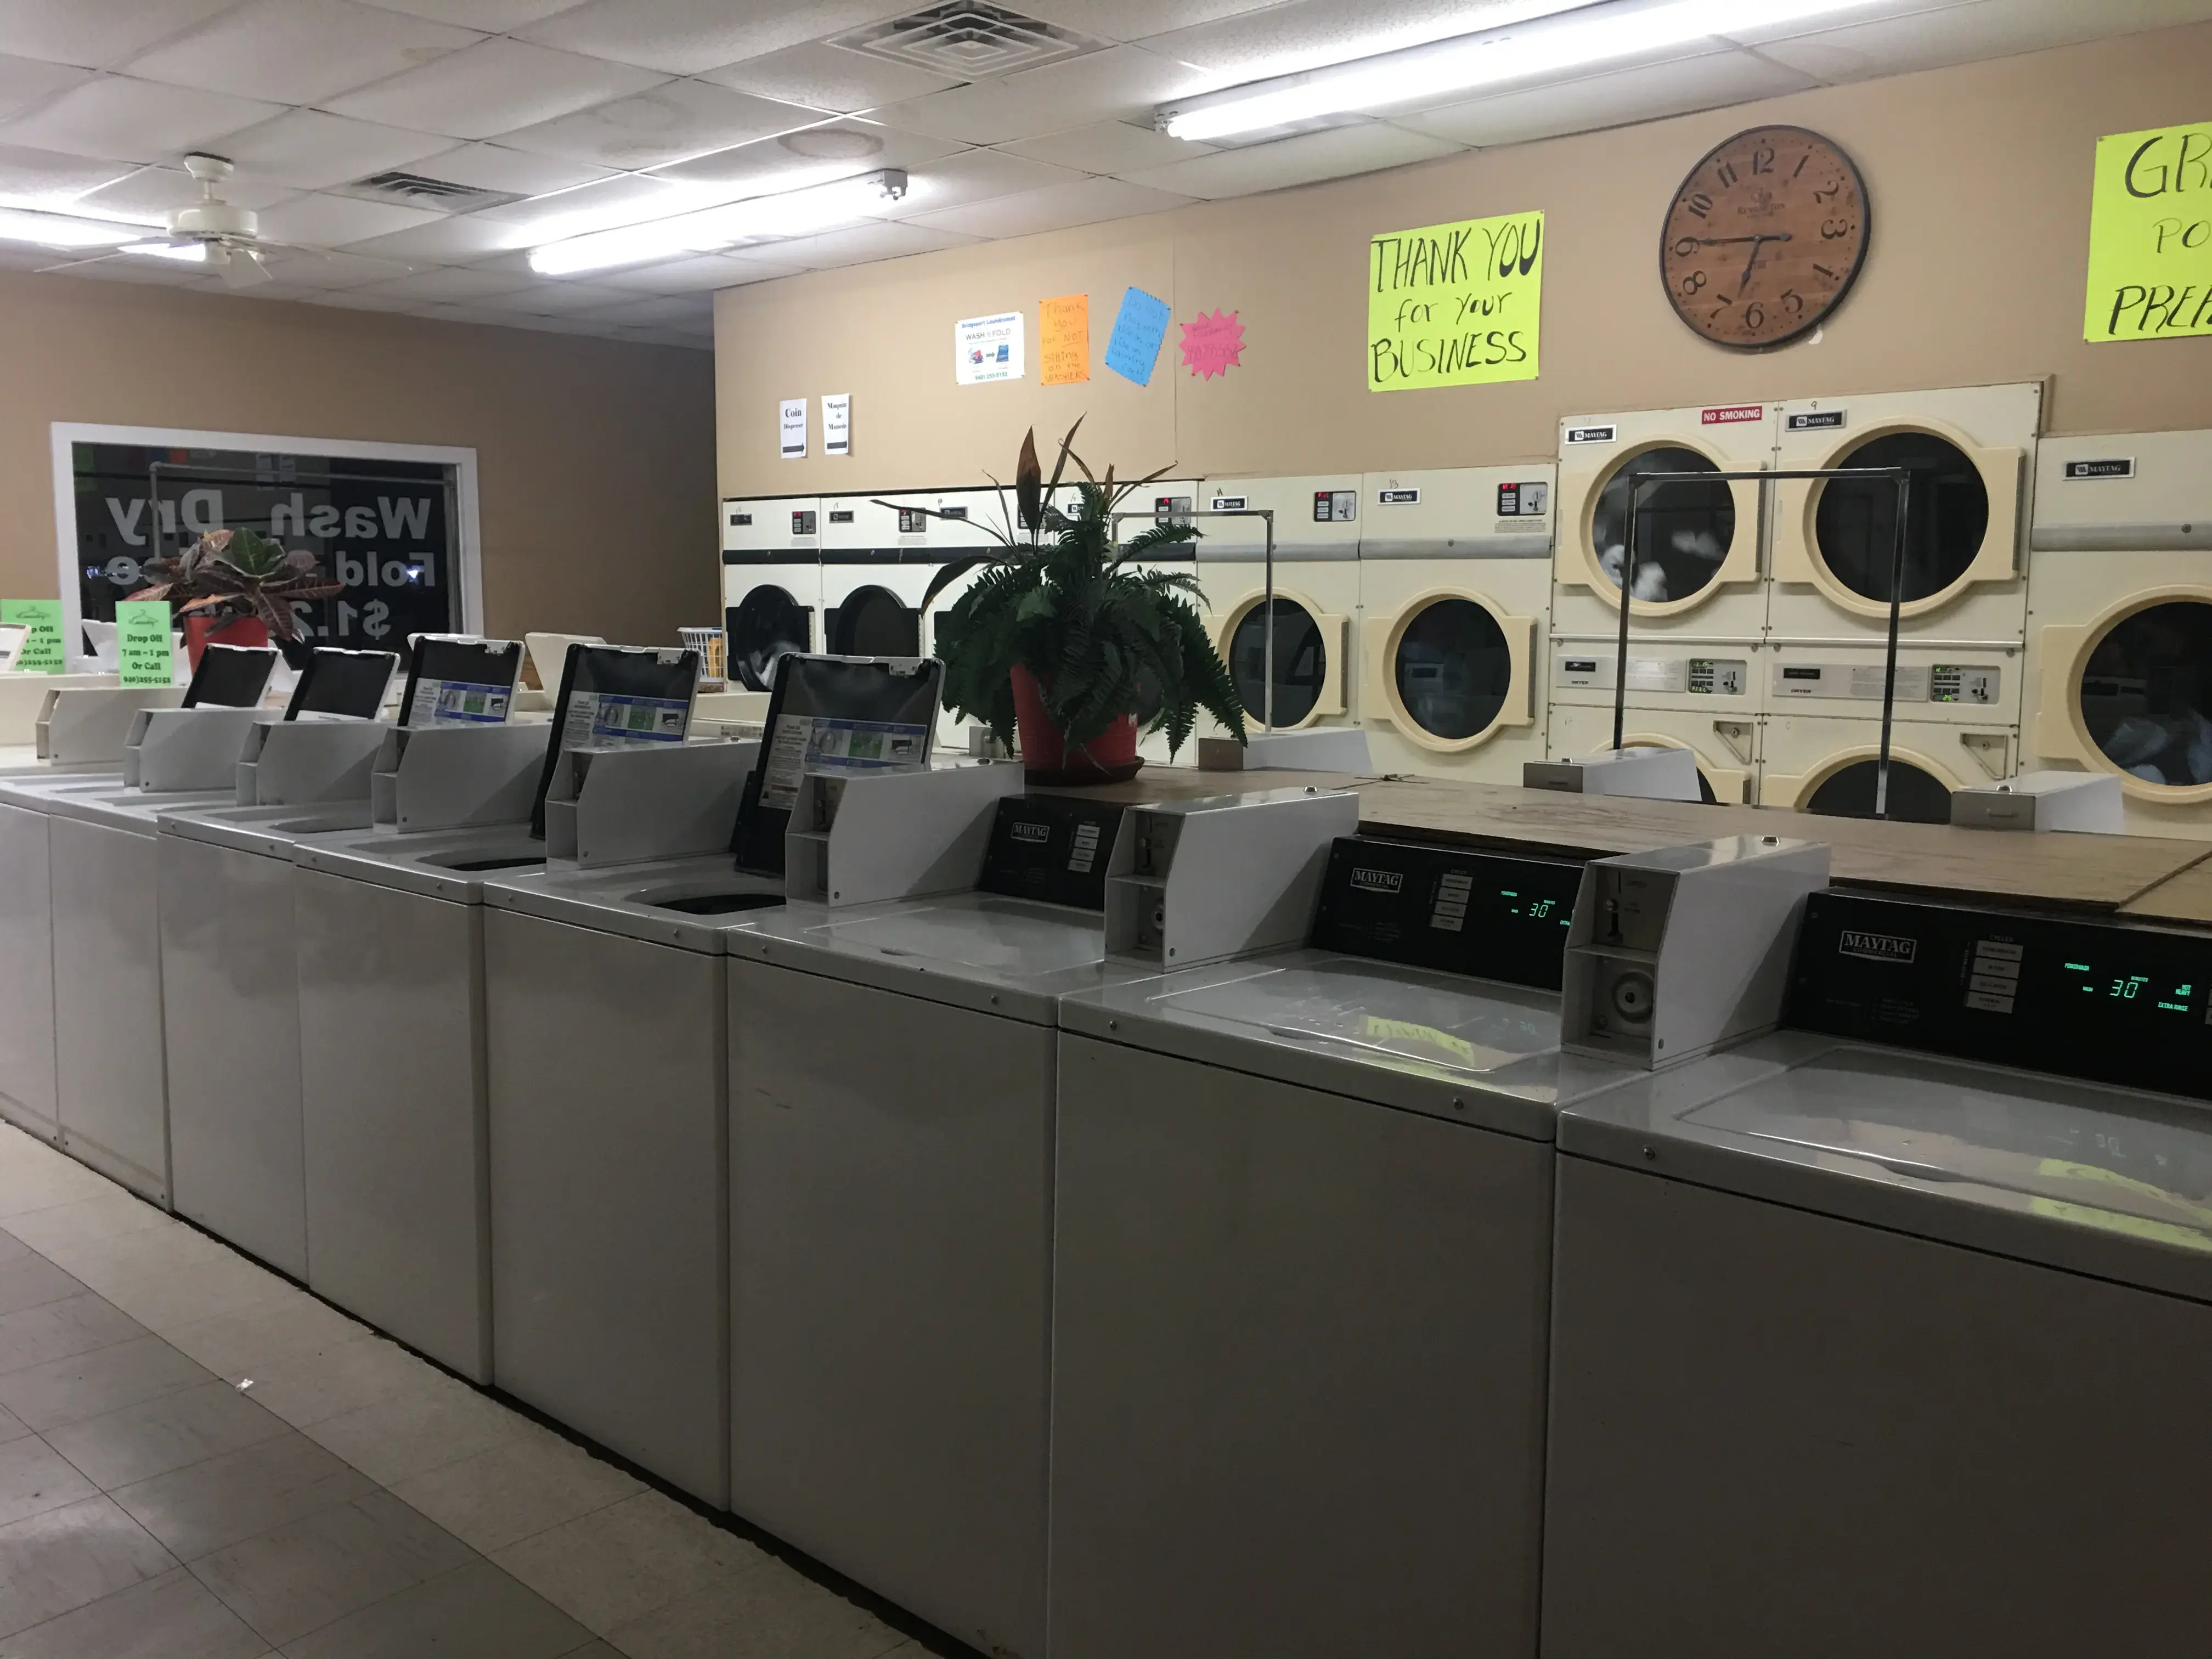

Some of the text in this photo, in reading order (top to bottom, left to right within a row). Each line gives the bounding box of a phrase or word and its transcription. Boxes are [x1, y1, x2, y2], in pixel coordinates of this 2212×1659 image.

[1753, 148, 1774, 175] 12
[2125, 132, 2212, 198] GR
[1717, 162, 1738, 188] 11
[1813, 180, 1839, 204] 2
[1689, 193, 1713, 219] 10
[1821, 219, 1847, 239] 3
[1371, 218, 1541, 292] THANK YOU
[1675, 236, 1700, 257] 9
[1683, 270, 1707, 295] 8
[1043, 302, 1085, 318] Thank
[1710, 294, 1733, 319] 7
[1780, 289, 1803, 314] 5
[986, 316, 1015, 324] Laundromat
[1395, 298, 1438, 332] for
[1745, 302, 1764, 329] 6
[966, 332, 985, 340] WASH
[992, 328, 1011, 337] FOLD
[1064, 331, 1085, 342] NOT
[1371, 331, 1526, 382] BUSINESS
[785, 408, 802, 417] Coin
[1703, 409, 1760, 422] NO SMOKING
[1389, 478, 1398, 489] 13
[127, 634, 162, 644] Drop Off
[1014, 825, 1047, 837] MAYTAG
[1354, 870, 1399, 885] MAYTAG
[1529, 903, 1548, 918] 30
[1844, 934, 1911, 954] MAYTAG
[2109, 979, 2138, 998] 30
